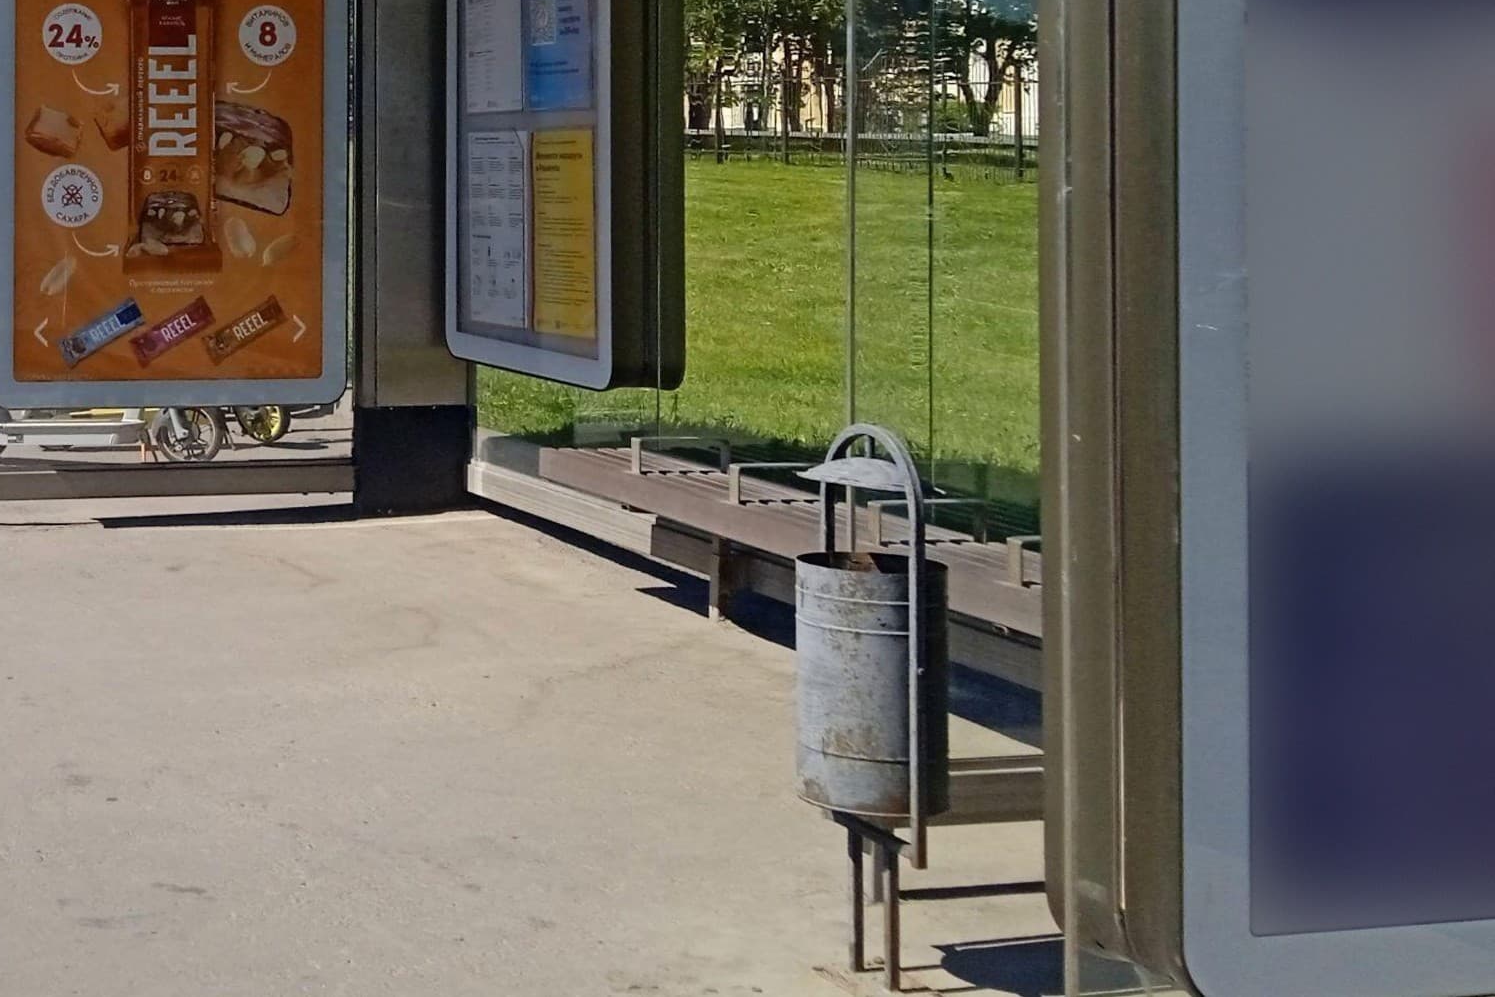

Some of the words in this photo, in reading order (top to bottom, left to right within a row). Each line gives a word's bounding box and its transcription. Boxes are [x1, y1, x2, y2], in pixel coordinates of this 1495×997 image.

[47, 23, 100, 49] 24%
[258, 21, 278, 47] 8
[148, 34, 197, 156] REEEL
[55, 211, 89, 223] САХАРА
[89, 313, 129, 343] REEEL
[160, 313, 198, 343] REEEL
[231, 312, 269, 342] REEEL
